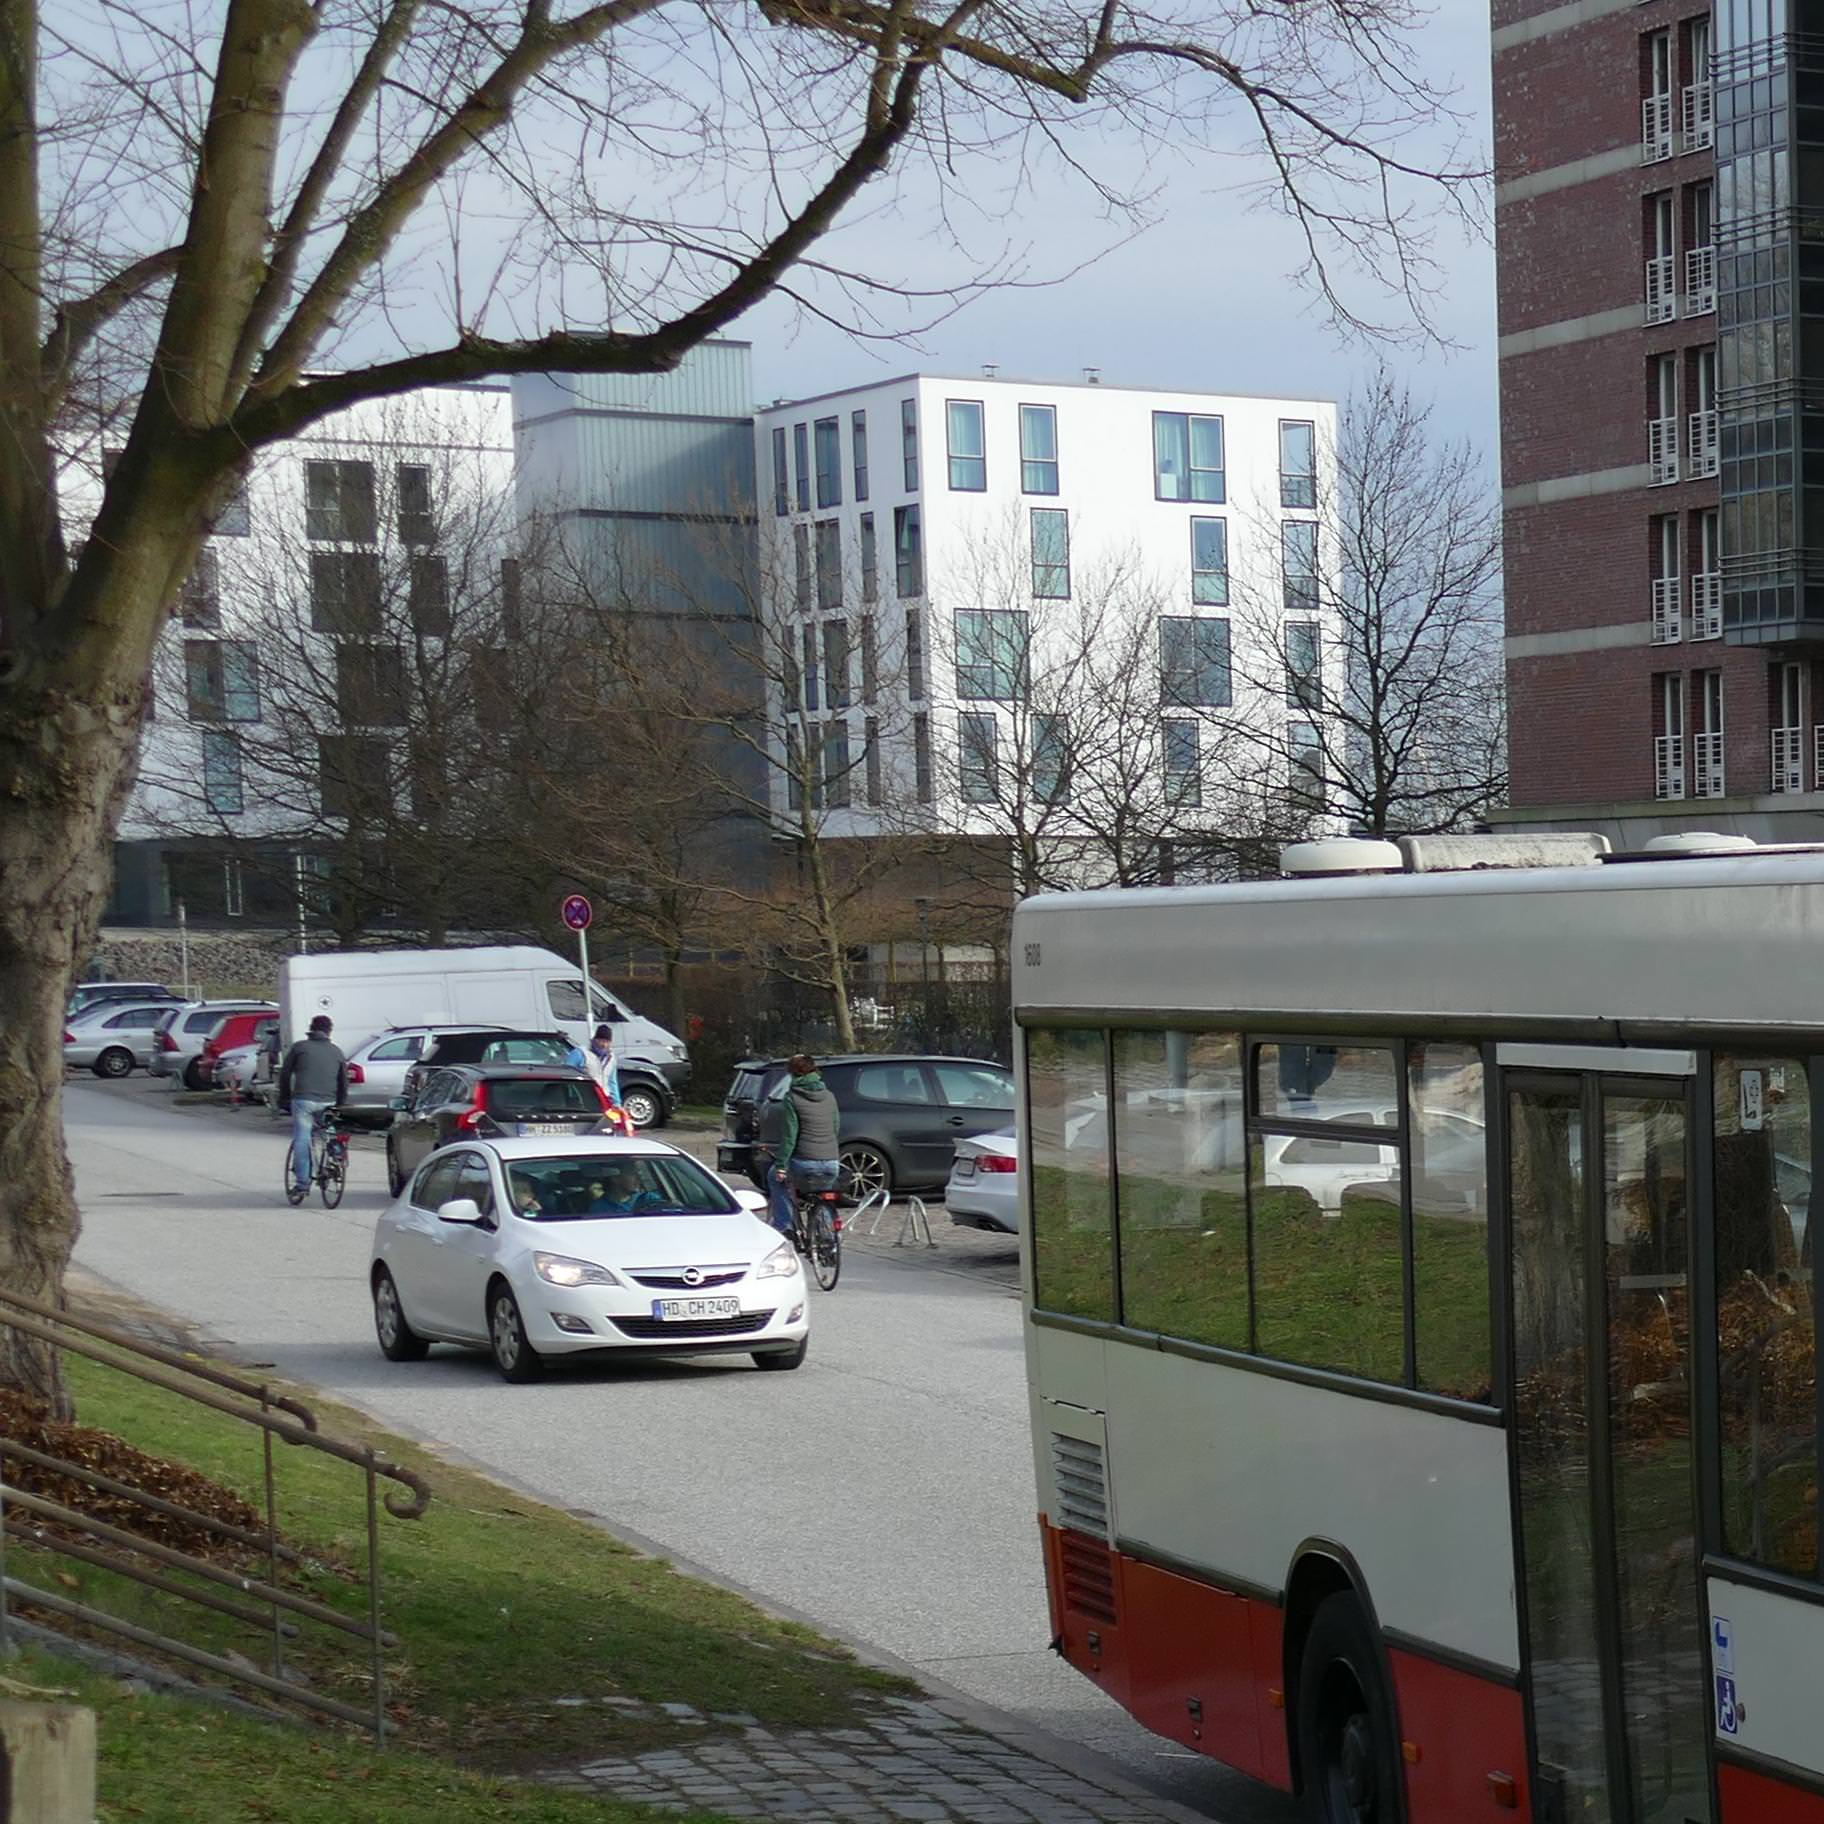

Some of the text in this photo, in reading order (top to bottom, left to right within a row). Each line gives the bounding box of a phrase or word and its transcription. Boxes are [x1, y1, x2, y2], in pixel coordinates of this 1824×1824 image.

[1023, 943, 1041, 967] 1608
[662, 1299, 739, 1316] HD CH 2409
